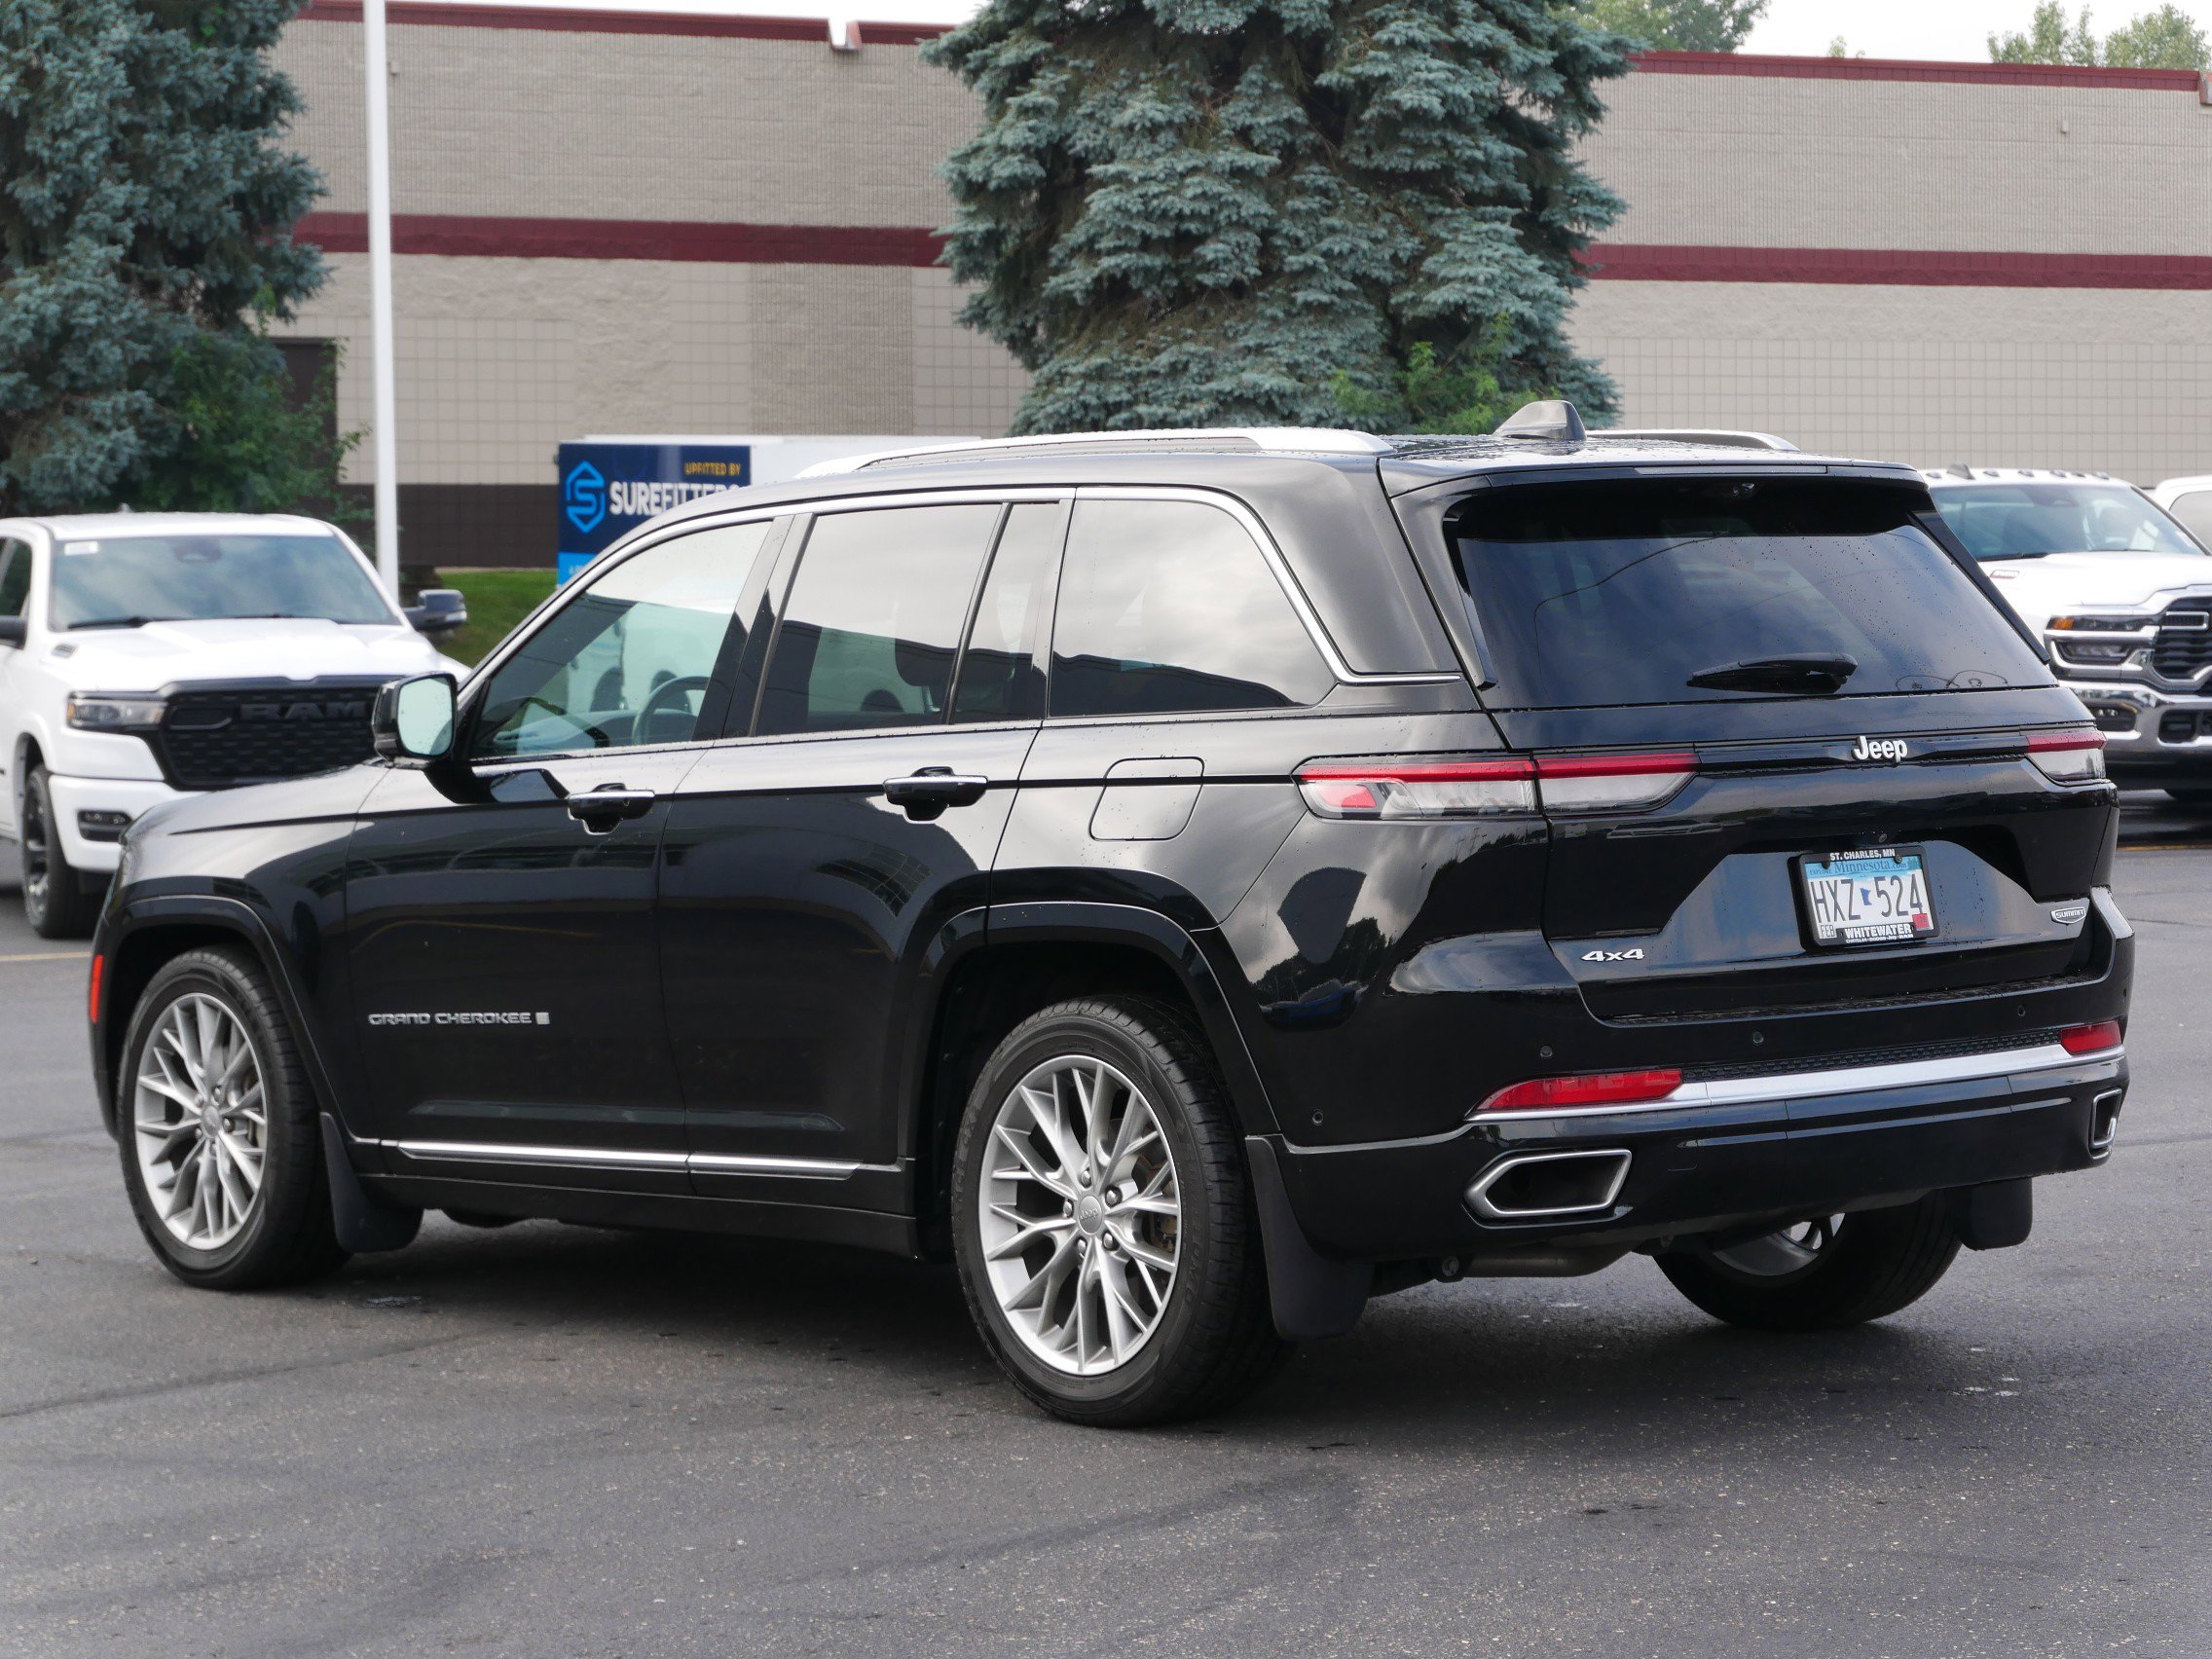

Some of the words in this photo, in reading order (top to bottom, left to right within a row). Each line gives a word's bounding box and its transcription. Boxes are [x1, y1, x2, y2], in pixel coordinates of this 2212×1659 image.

[684, 461, 726, 475] UPFITTED
[728, 462, 741, 476] BY
[240, 701, 367, 719] RAM
[1852, 735, 1908, 763] Jeep
[1830, 852, 1843, 862] ST.
[1844, 849, 1882, 860] CHARLES,
[1883, 848, 1896, 858] MN
[1811, 878, 1862, 924] HXZ
[1874, 873, 1924, 918] 524
[1844, 923, 1912, 940] WHITEWATER
[1581, 948, 1645, 962] 4x4
[368, 1014, 431, 1025] GRAND
[434, 1013, 533, 1024] CHEROKEE
